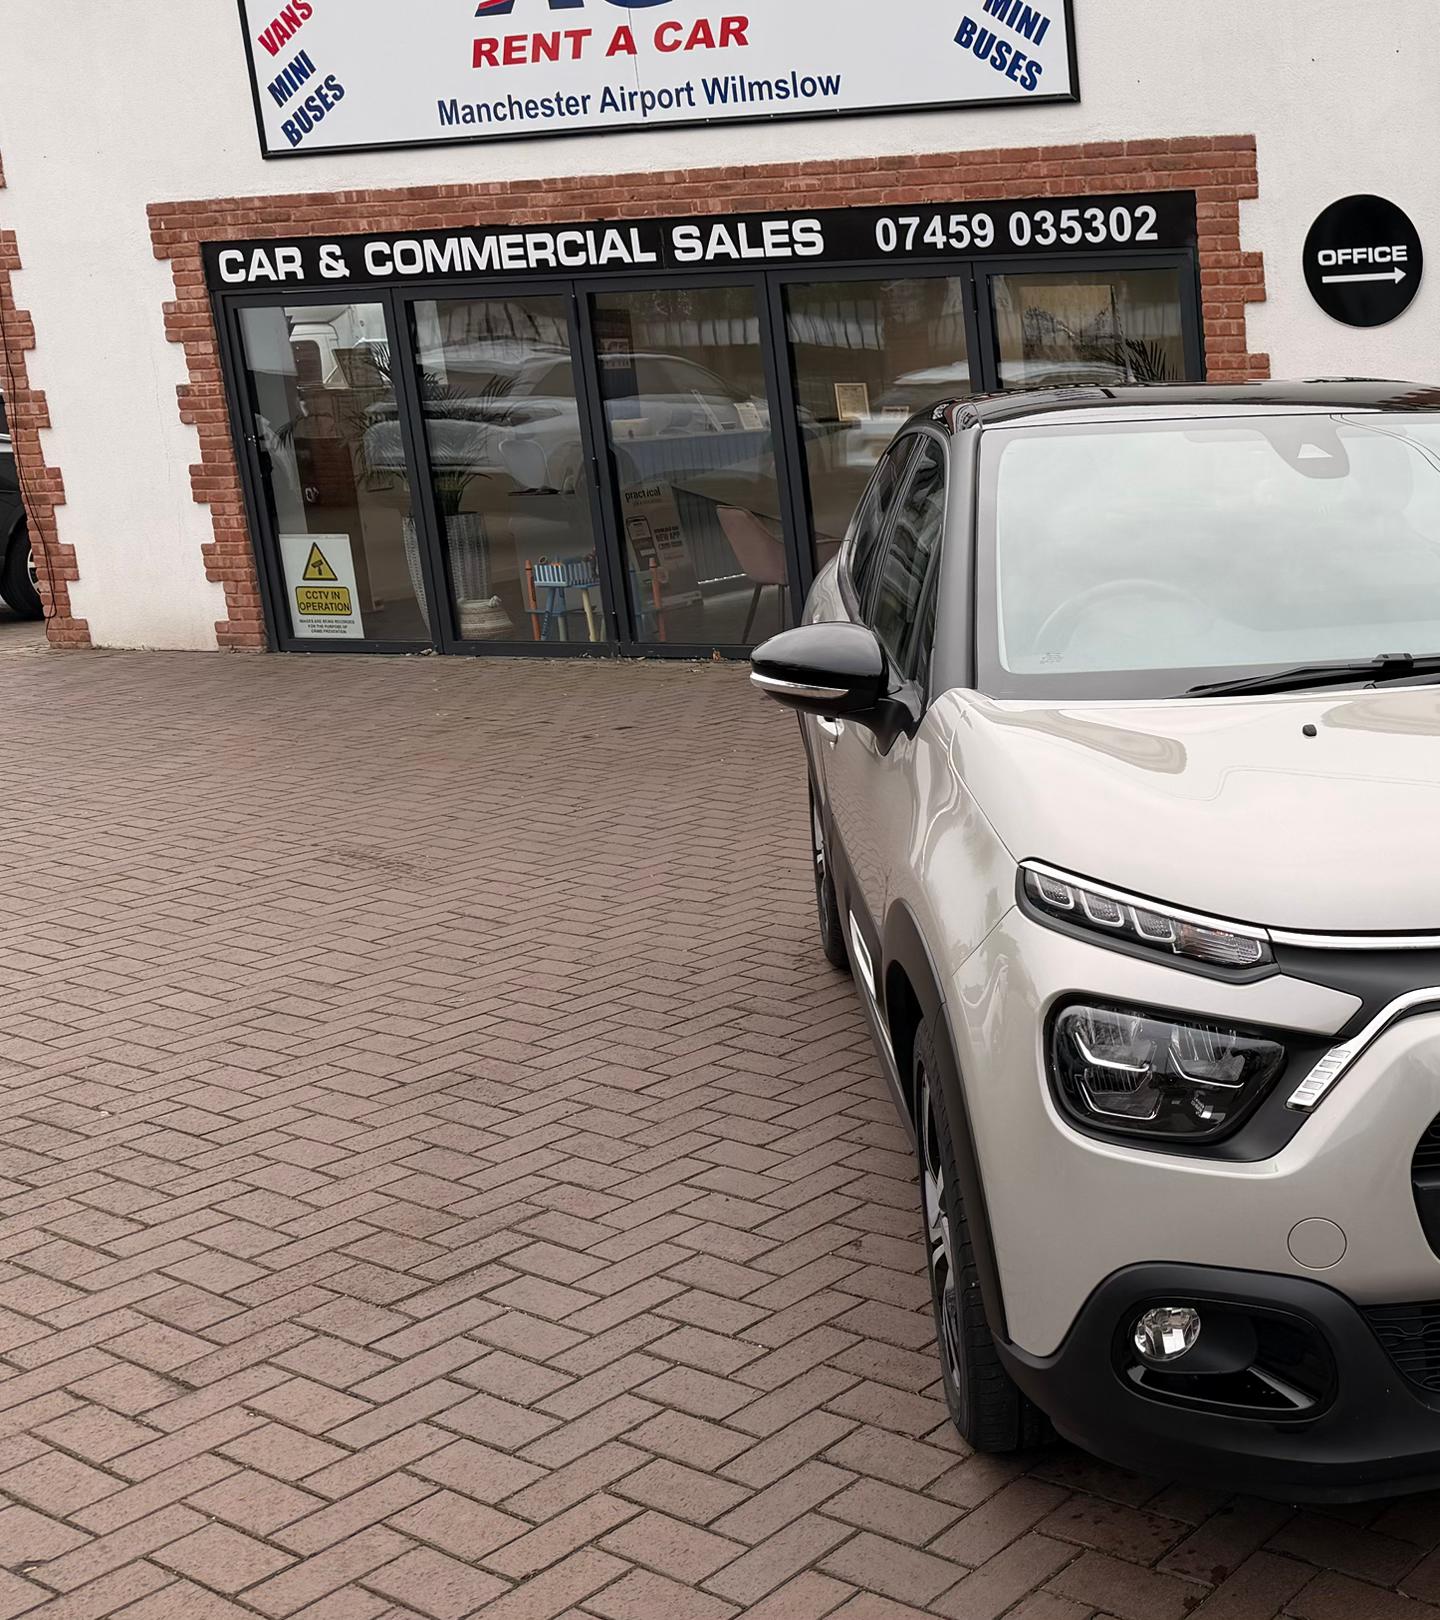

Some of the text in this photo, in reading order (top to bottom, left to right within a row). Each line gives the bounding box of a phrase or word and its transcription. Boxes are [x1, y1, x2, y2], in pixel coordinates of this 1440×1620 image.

[257, 0, 313, 57] VANS
[472, 15, 750, 69] RENT A CAR
[982, 0, 1051, 46] MINI
[267, 49, 317, 108] MINI
[953, 15, 1043, 92] BUSES
[280, 74, 345, 148] BUSES
[437, 71, 841, 126] Manchester Airport Wilmslow
[218, 205, 1159, 283] CAR & COMMERCIAL SALES 07459 035302
[1317, 245, 1408, 266] OFFICE
[624, 486, 661, 503] practical
[299, 602, 350, 611] OPERATION
[305, 590, 341, 600] CCTV IN
